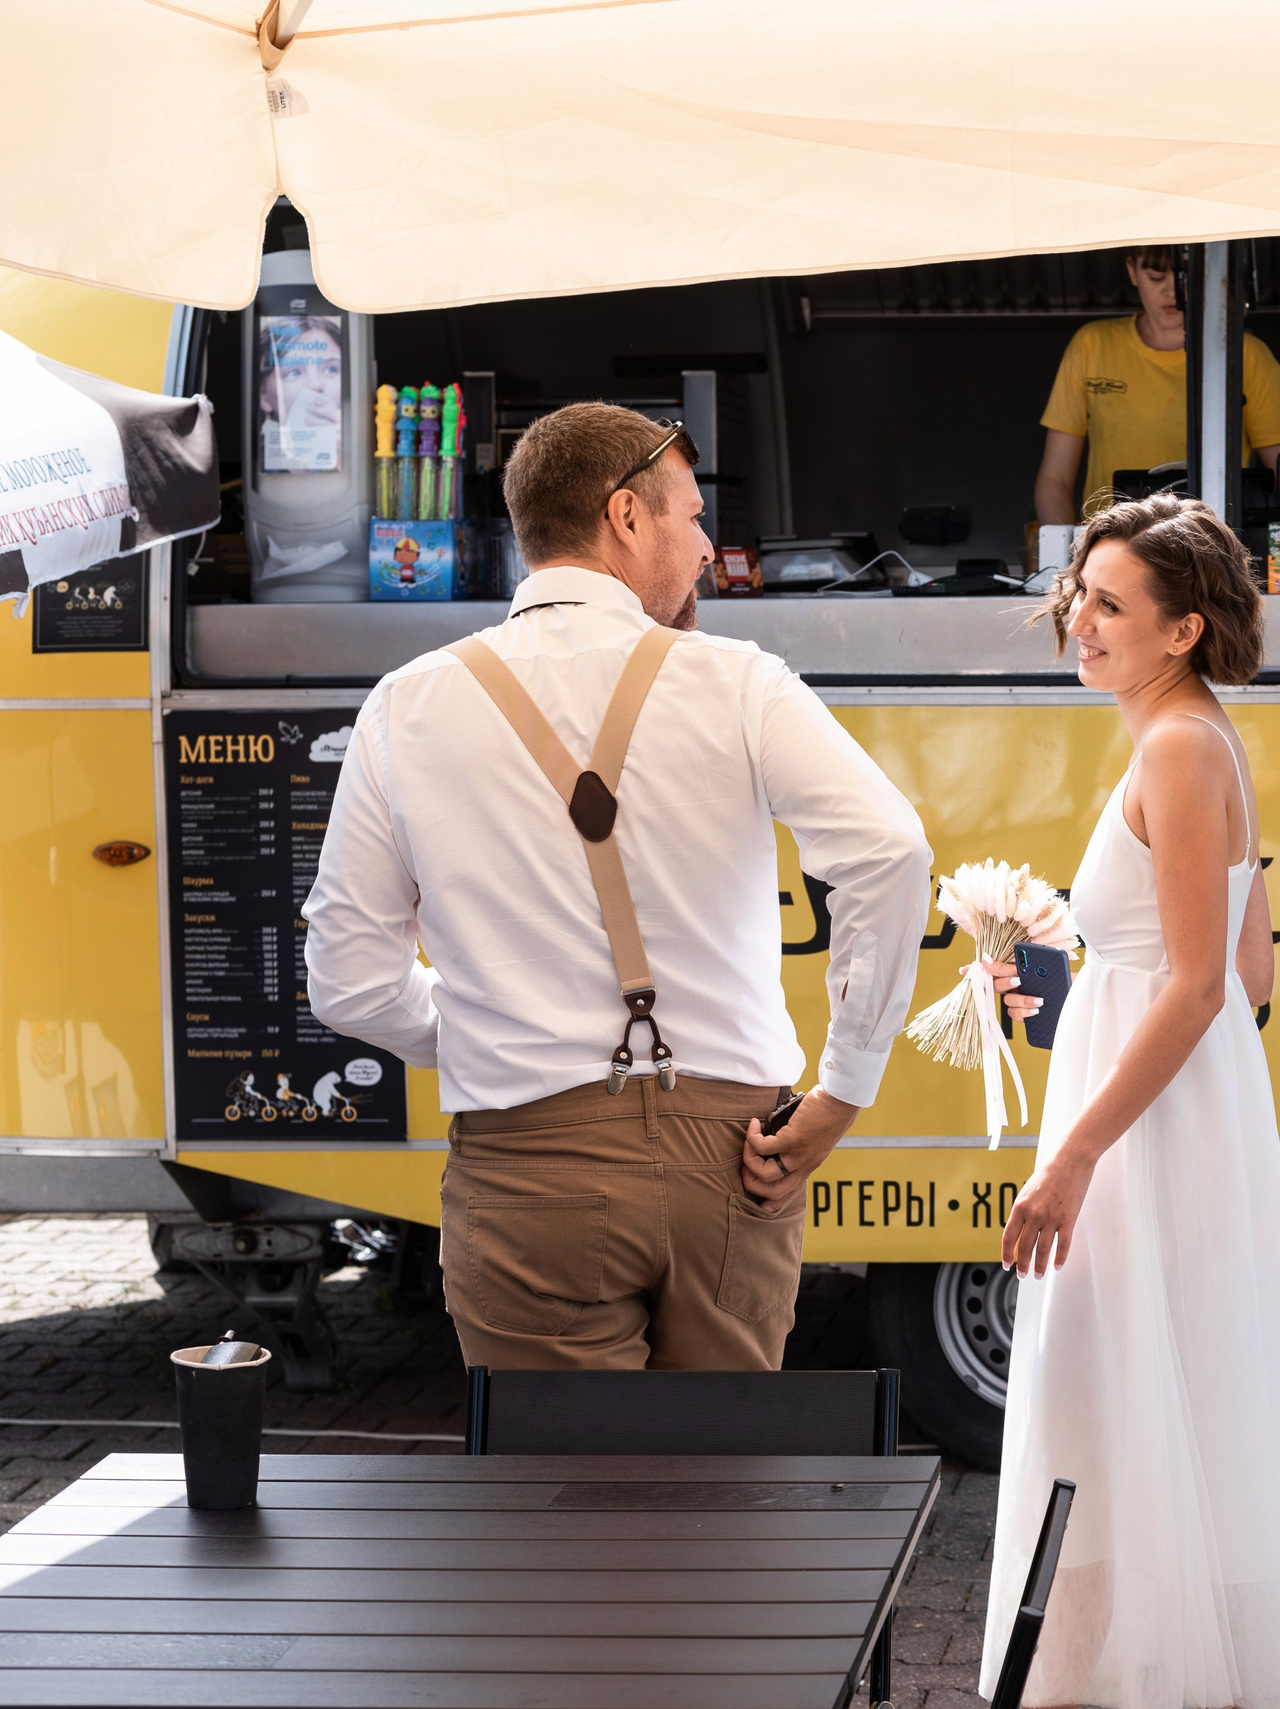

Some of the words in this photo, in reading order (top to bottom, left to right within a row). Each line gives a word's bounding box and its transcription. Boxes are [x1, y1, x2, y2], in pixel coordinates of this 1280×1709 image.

[7, 448, 92, 491] МОРОЖЕНОЕ
[17, 494, 99, 546] КУБАНСКИХ
[178, 734, 275, 764] МЕНЮ
[182, 876, 214, 887] Шаурма
[184, 913, 216, 924] Закуски
